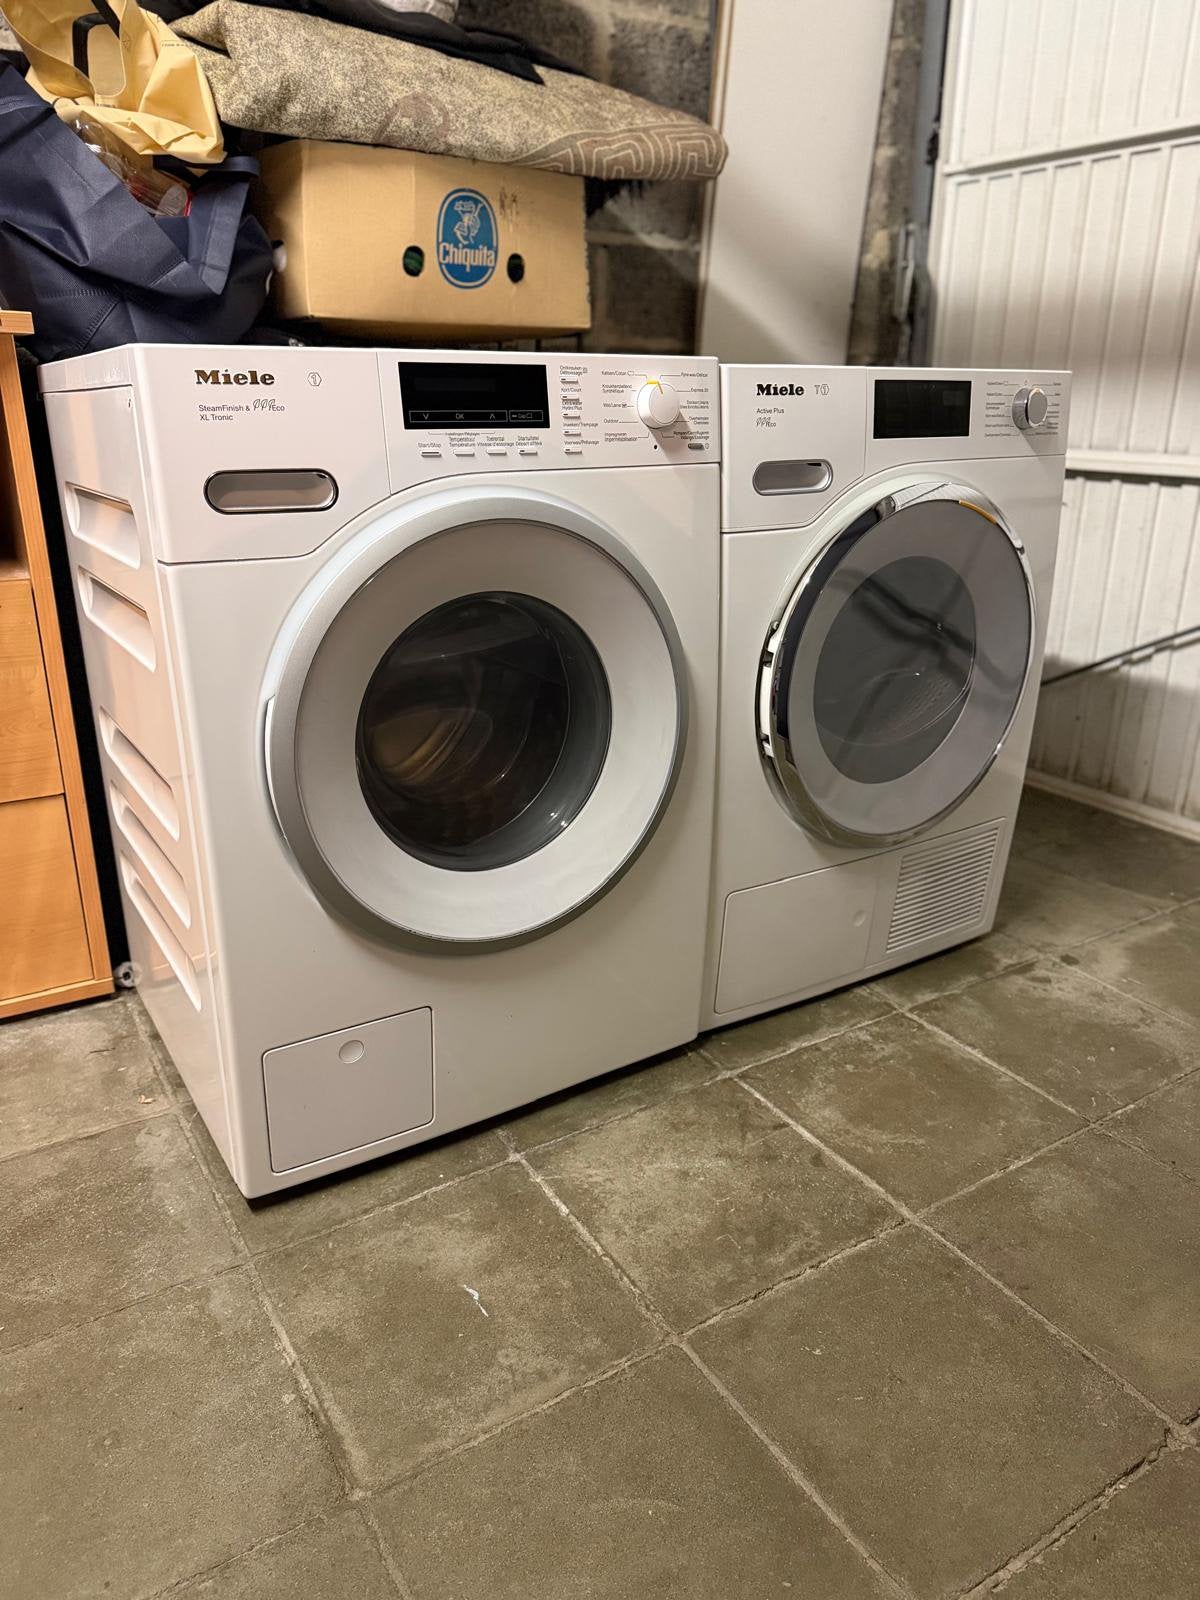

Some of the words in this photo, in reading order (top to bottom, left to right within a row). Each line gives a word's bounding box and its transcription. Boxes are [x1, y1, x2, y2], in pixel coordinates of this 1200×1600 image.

[439, 242, 495, 272] Chiquita
[194, 369, 275, 385] Miele
[756, 383, 804, 396] Miele
[198, 404, 244, 412] SteamFinish
[271, 404, 285, 412] Eco
[211, 413, 234, 421] Tronic
